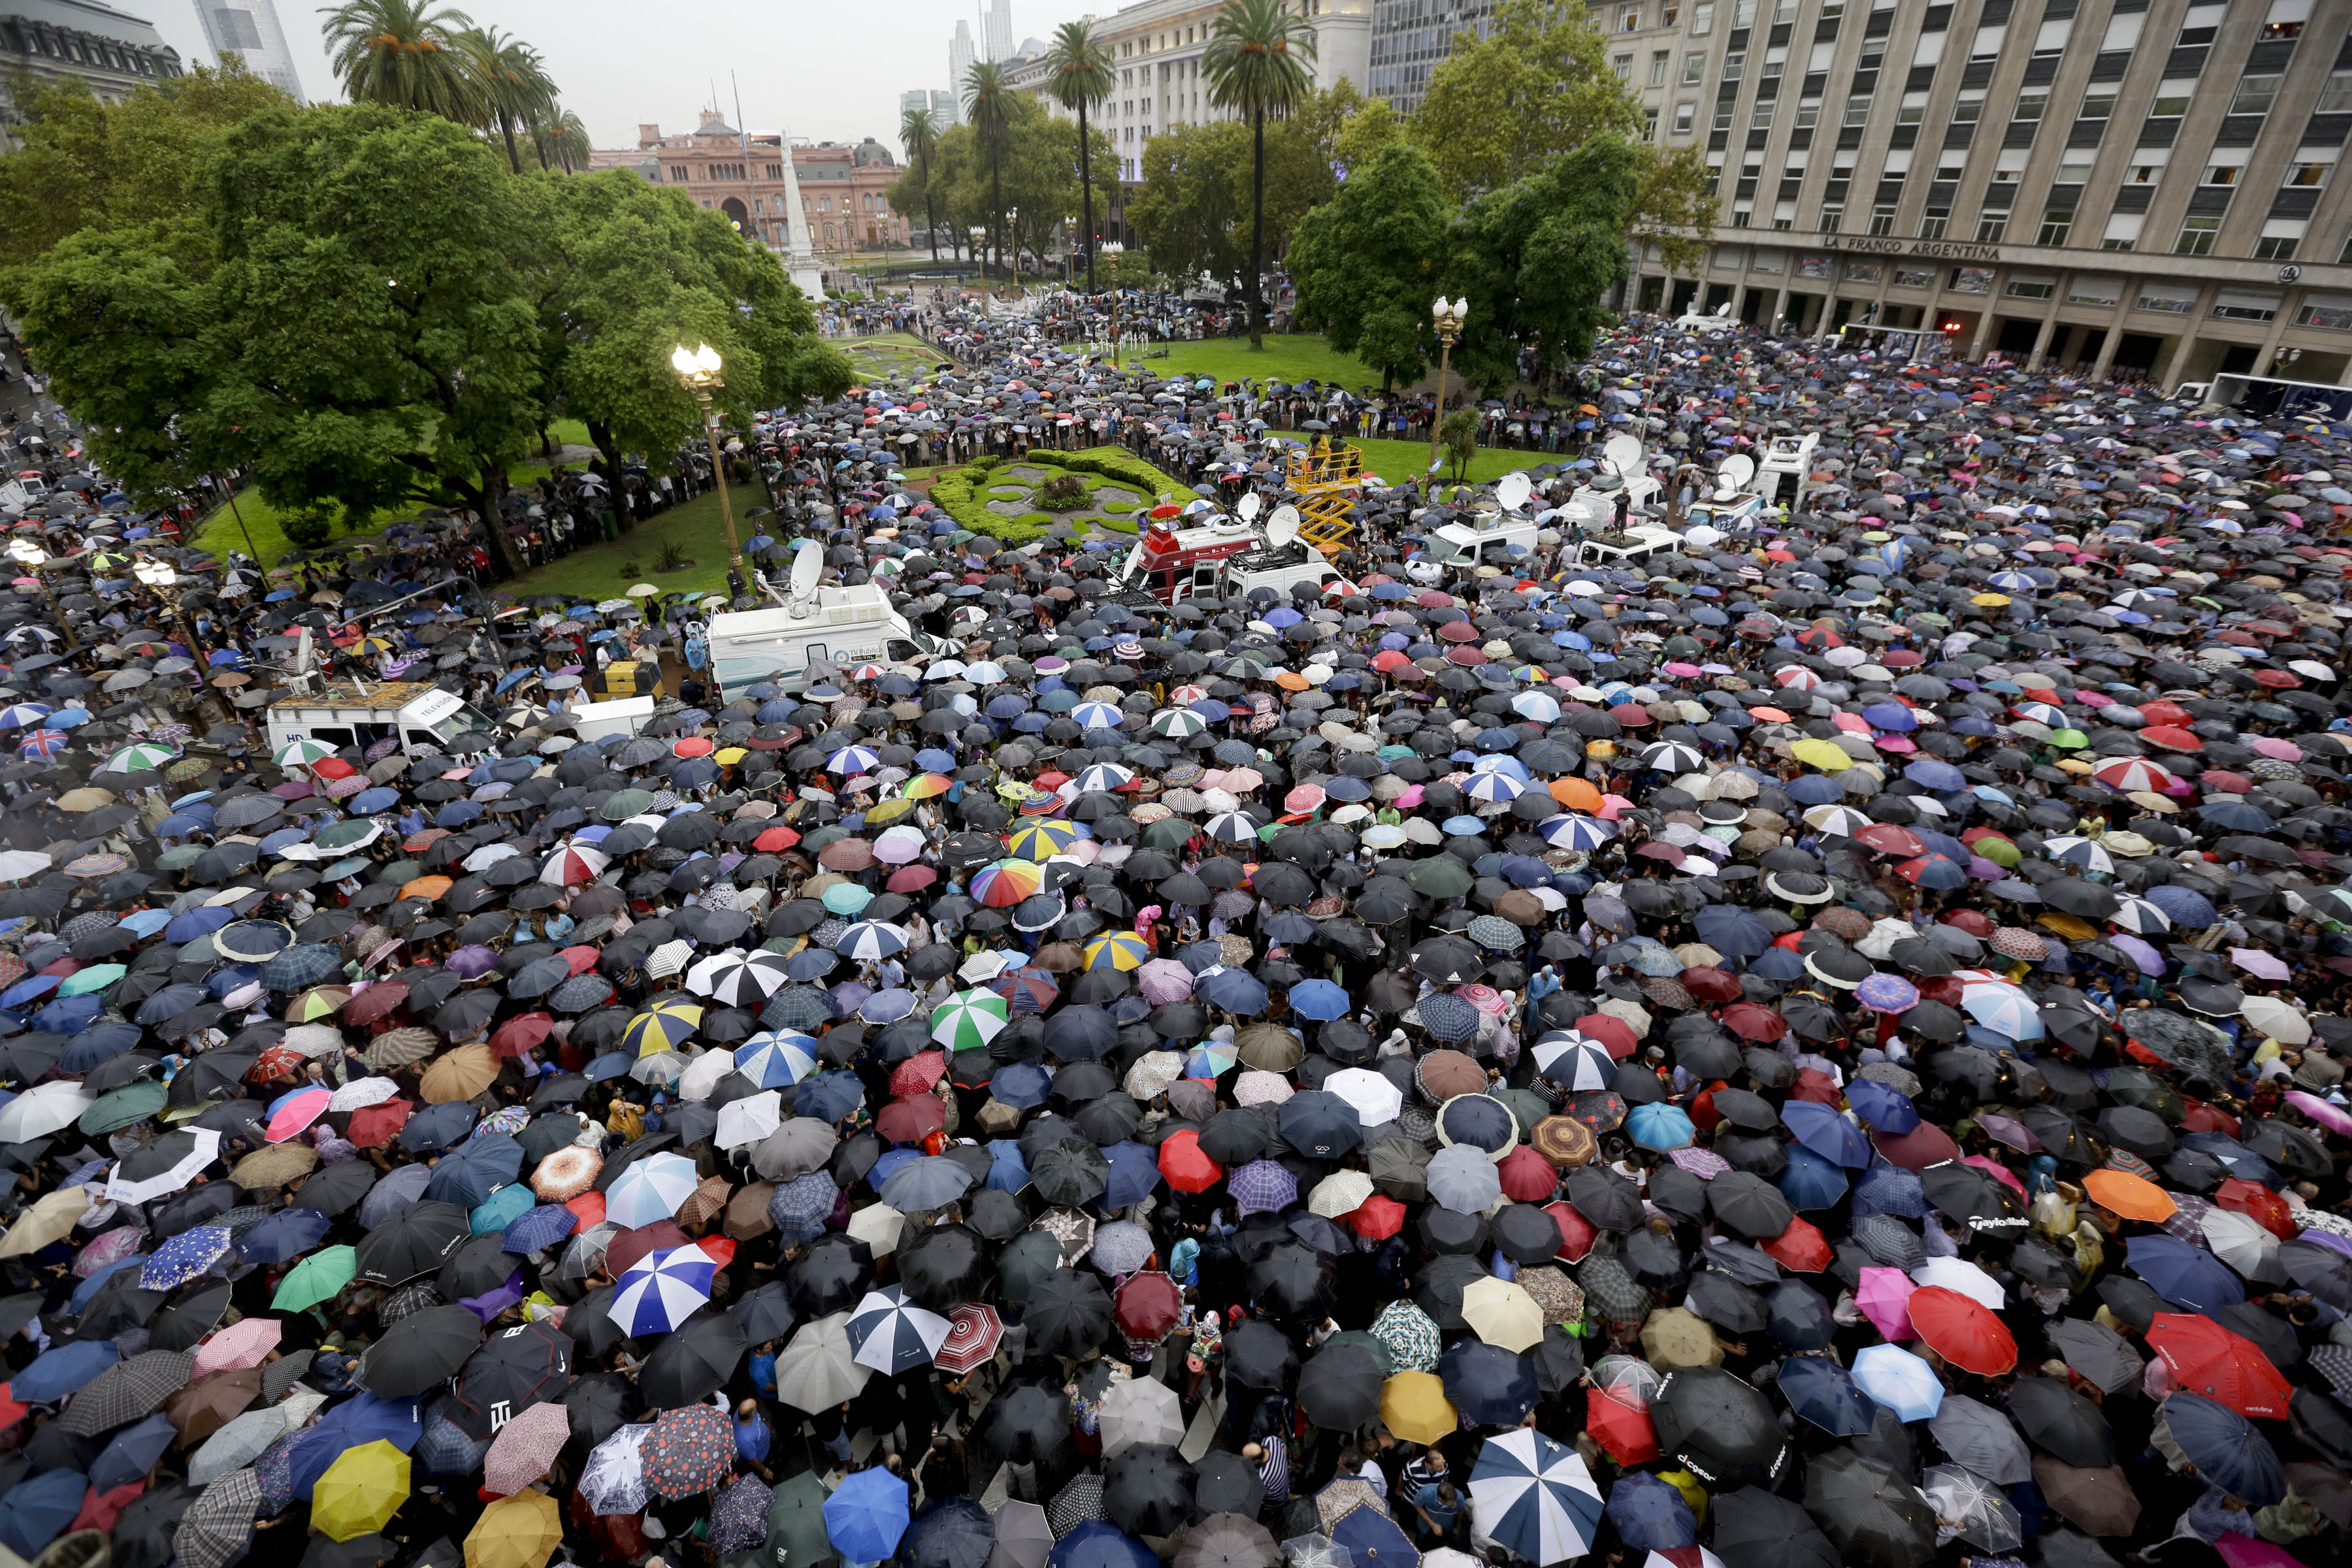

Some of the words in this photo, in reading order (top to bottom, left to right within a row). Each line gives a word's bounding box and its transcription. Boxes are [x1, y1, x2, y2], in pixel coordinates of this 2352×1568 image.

[1824, 237, 1839, 248] LA
[1848, 238, 1902, 253] FRANCO
[1909, 243, 2001, 260] ARGENTINA
[1968, 1215, 2030, 1230] TaylorMade
